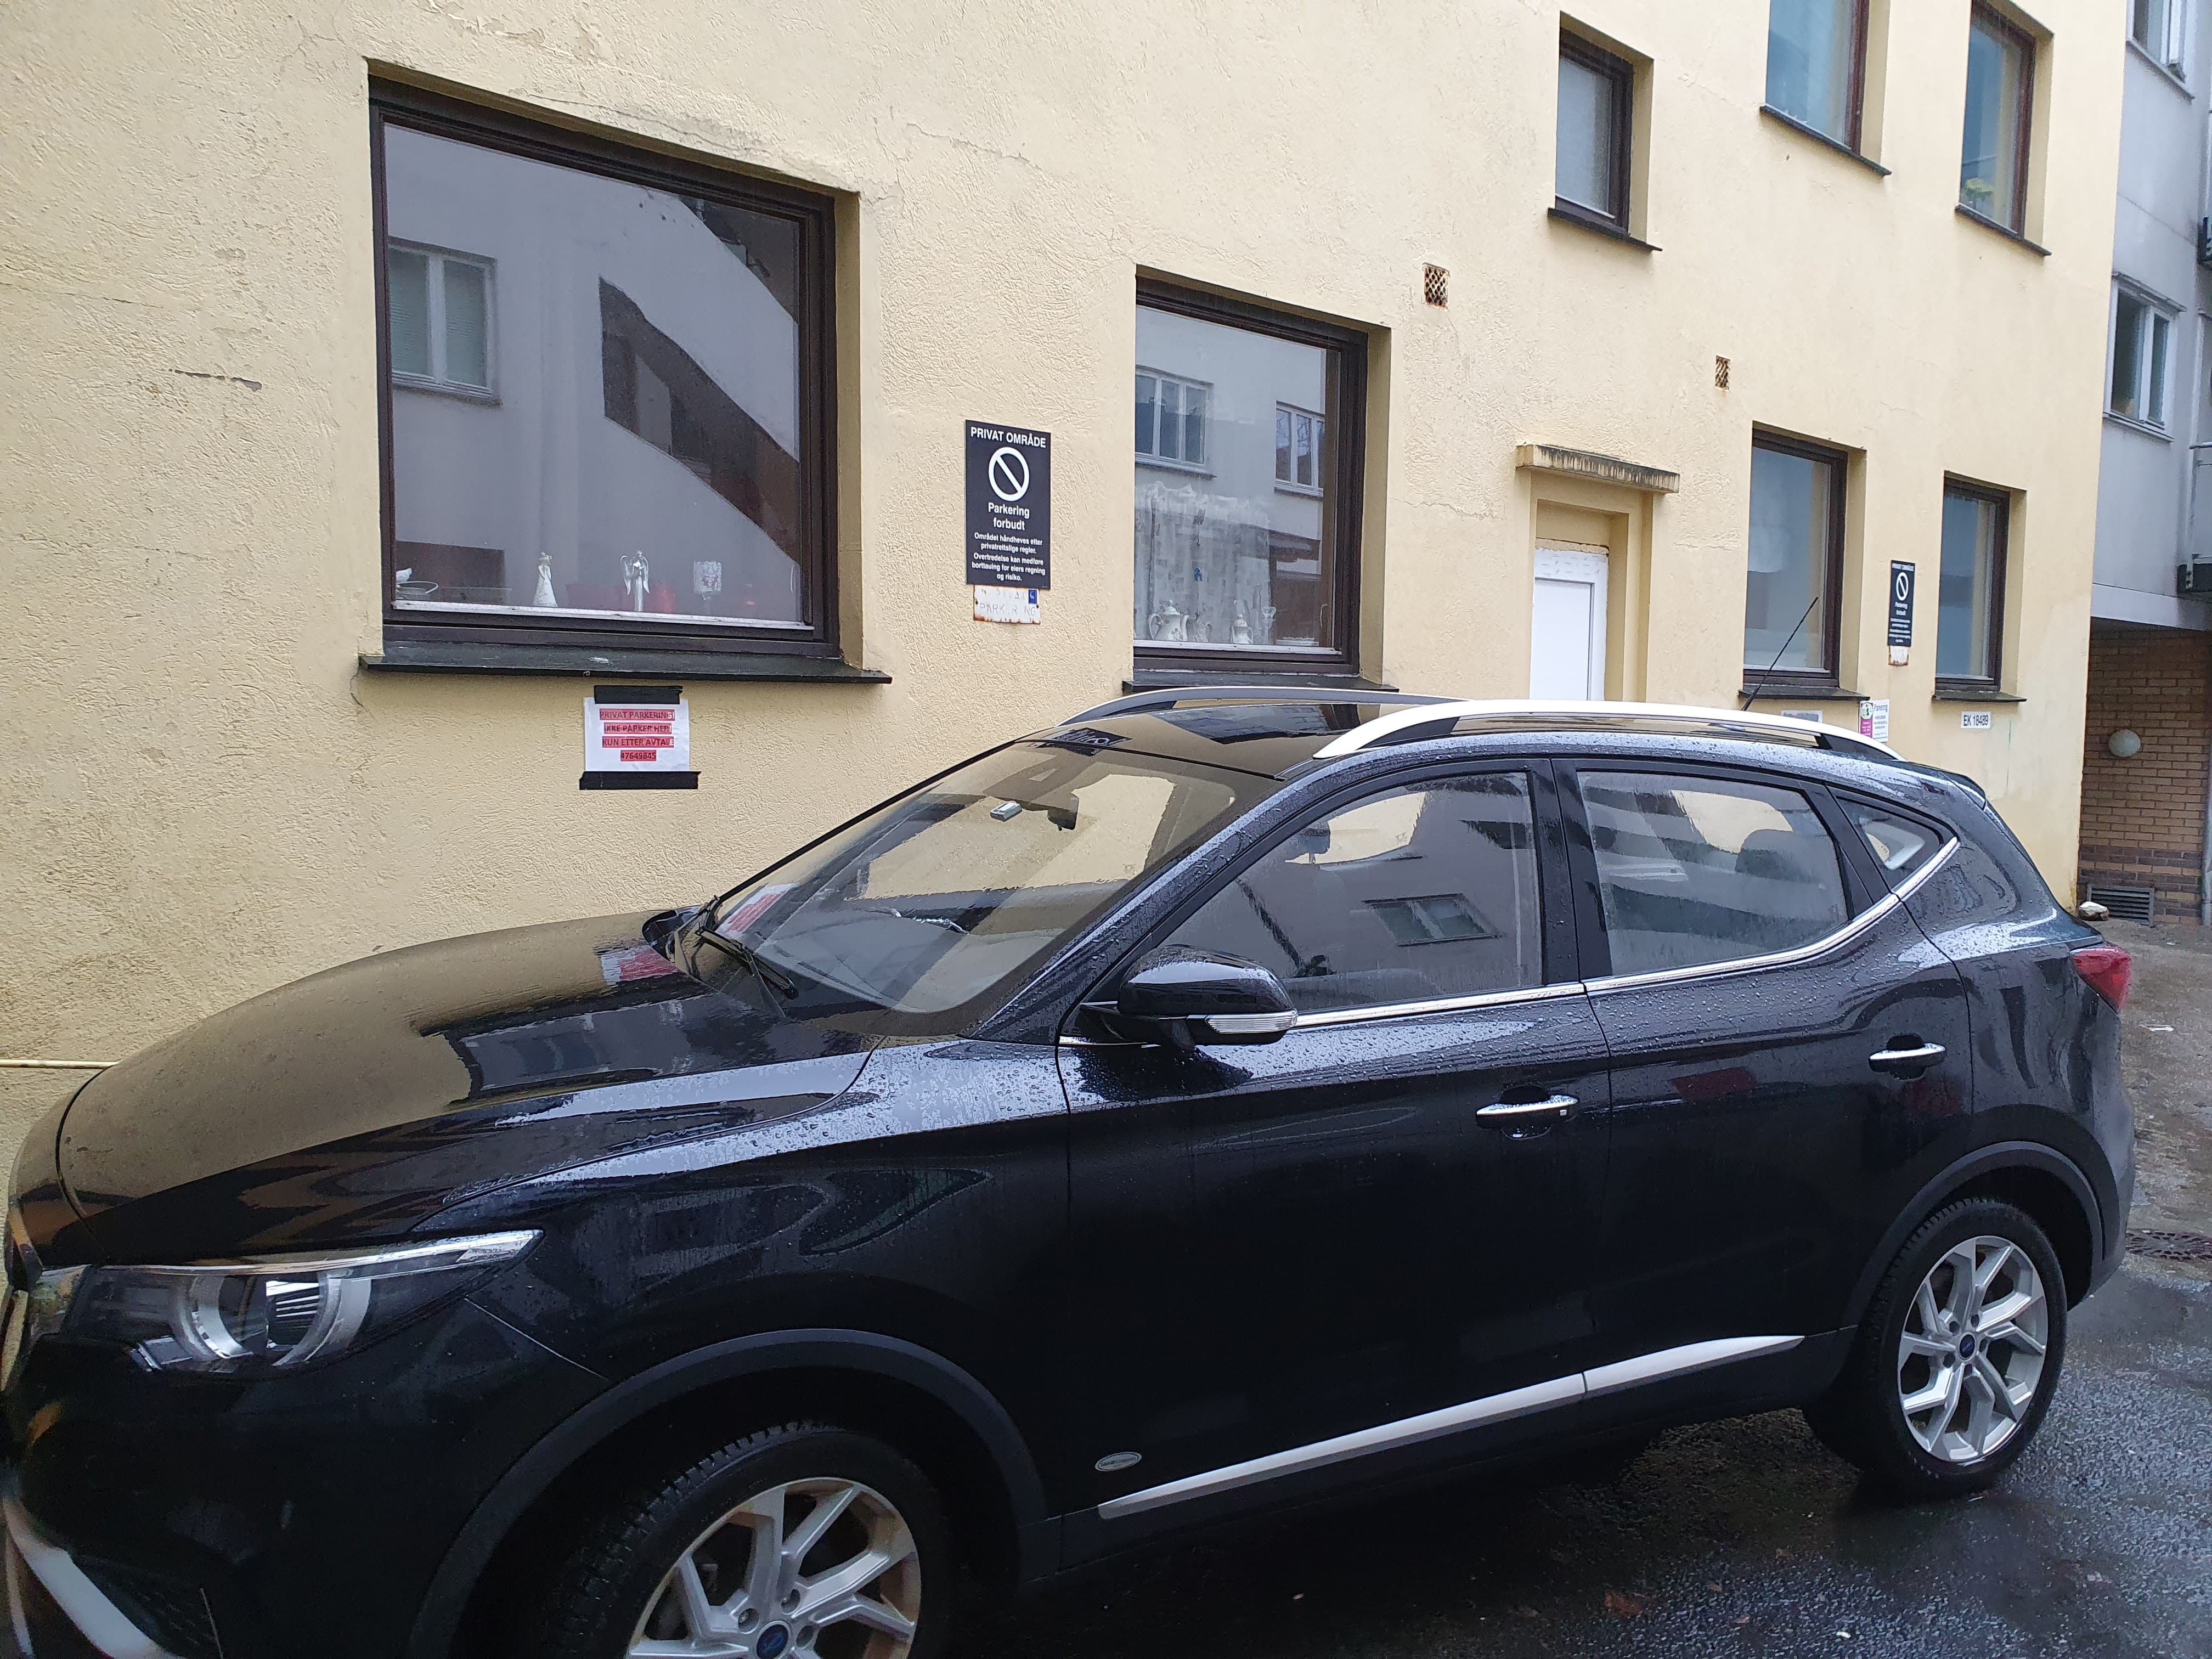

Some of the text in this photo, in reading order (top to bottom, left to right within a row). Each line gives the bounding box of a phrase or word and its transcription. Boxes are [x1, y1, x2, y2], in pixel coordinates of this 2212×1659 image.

[970, 426, 1046, 448] PRIVAT OMRÅDE
[988, 502, 1030, 519] Parkering
[993, 517, 1025, 531] forbudt
[973, 552, 1009, 562] Overtredelse
[1025, 567, 1046, 575] regning
[1963, 715, 1971, 726] EK
